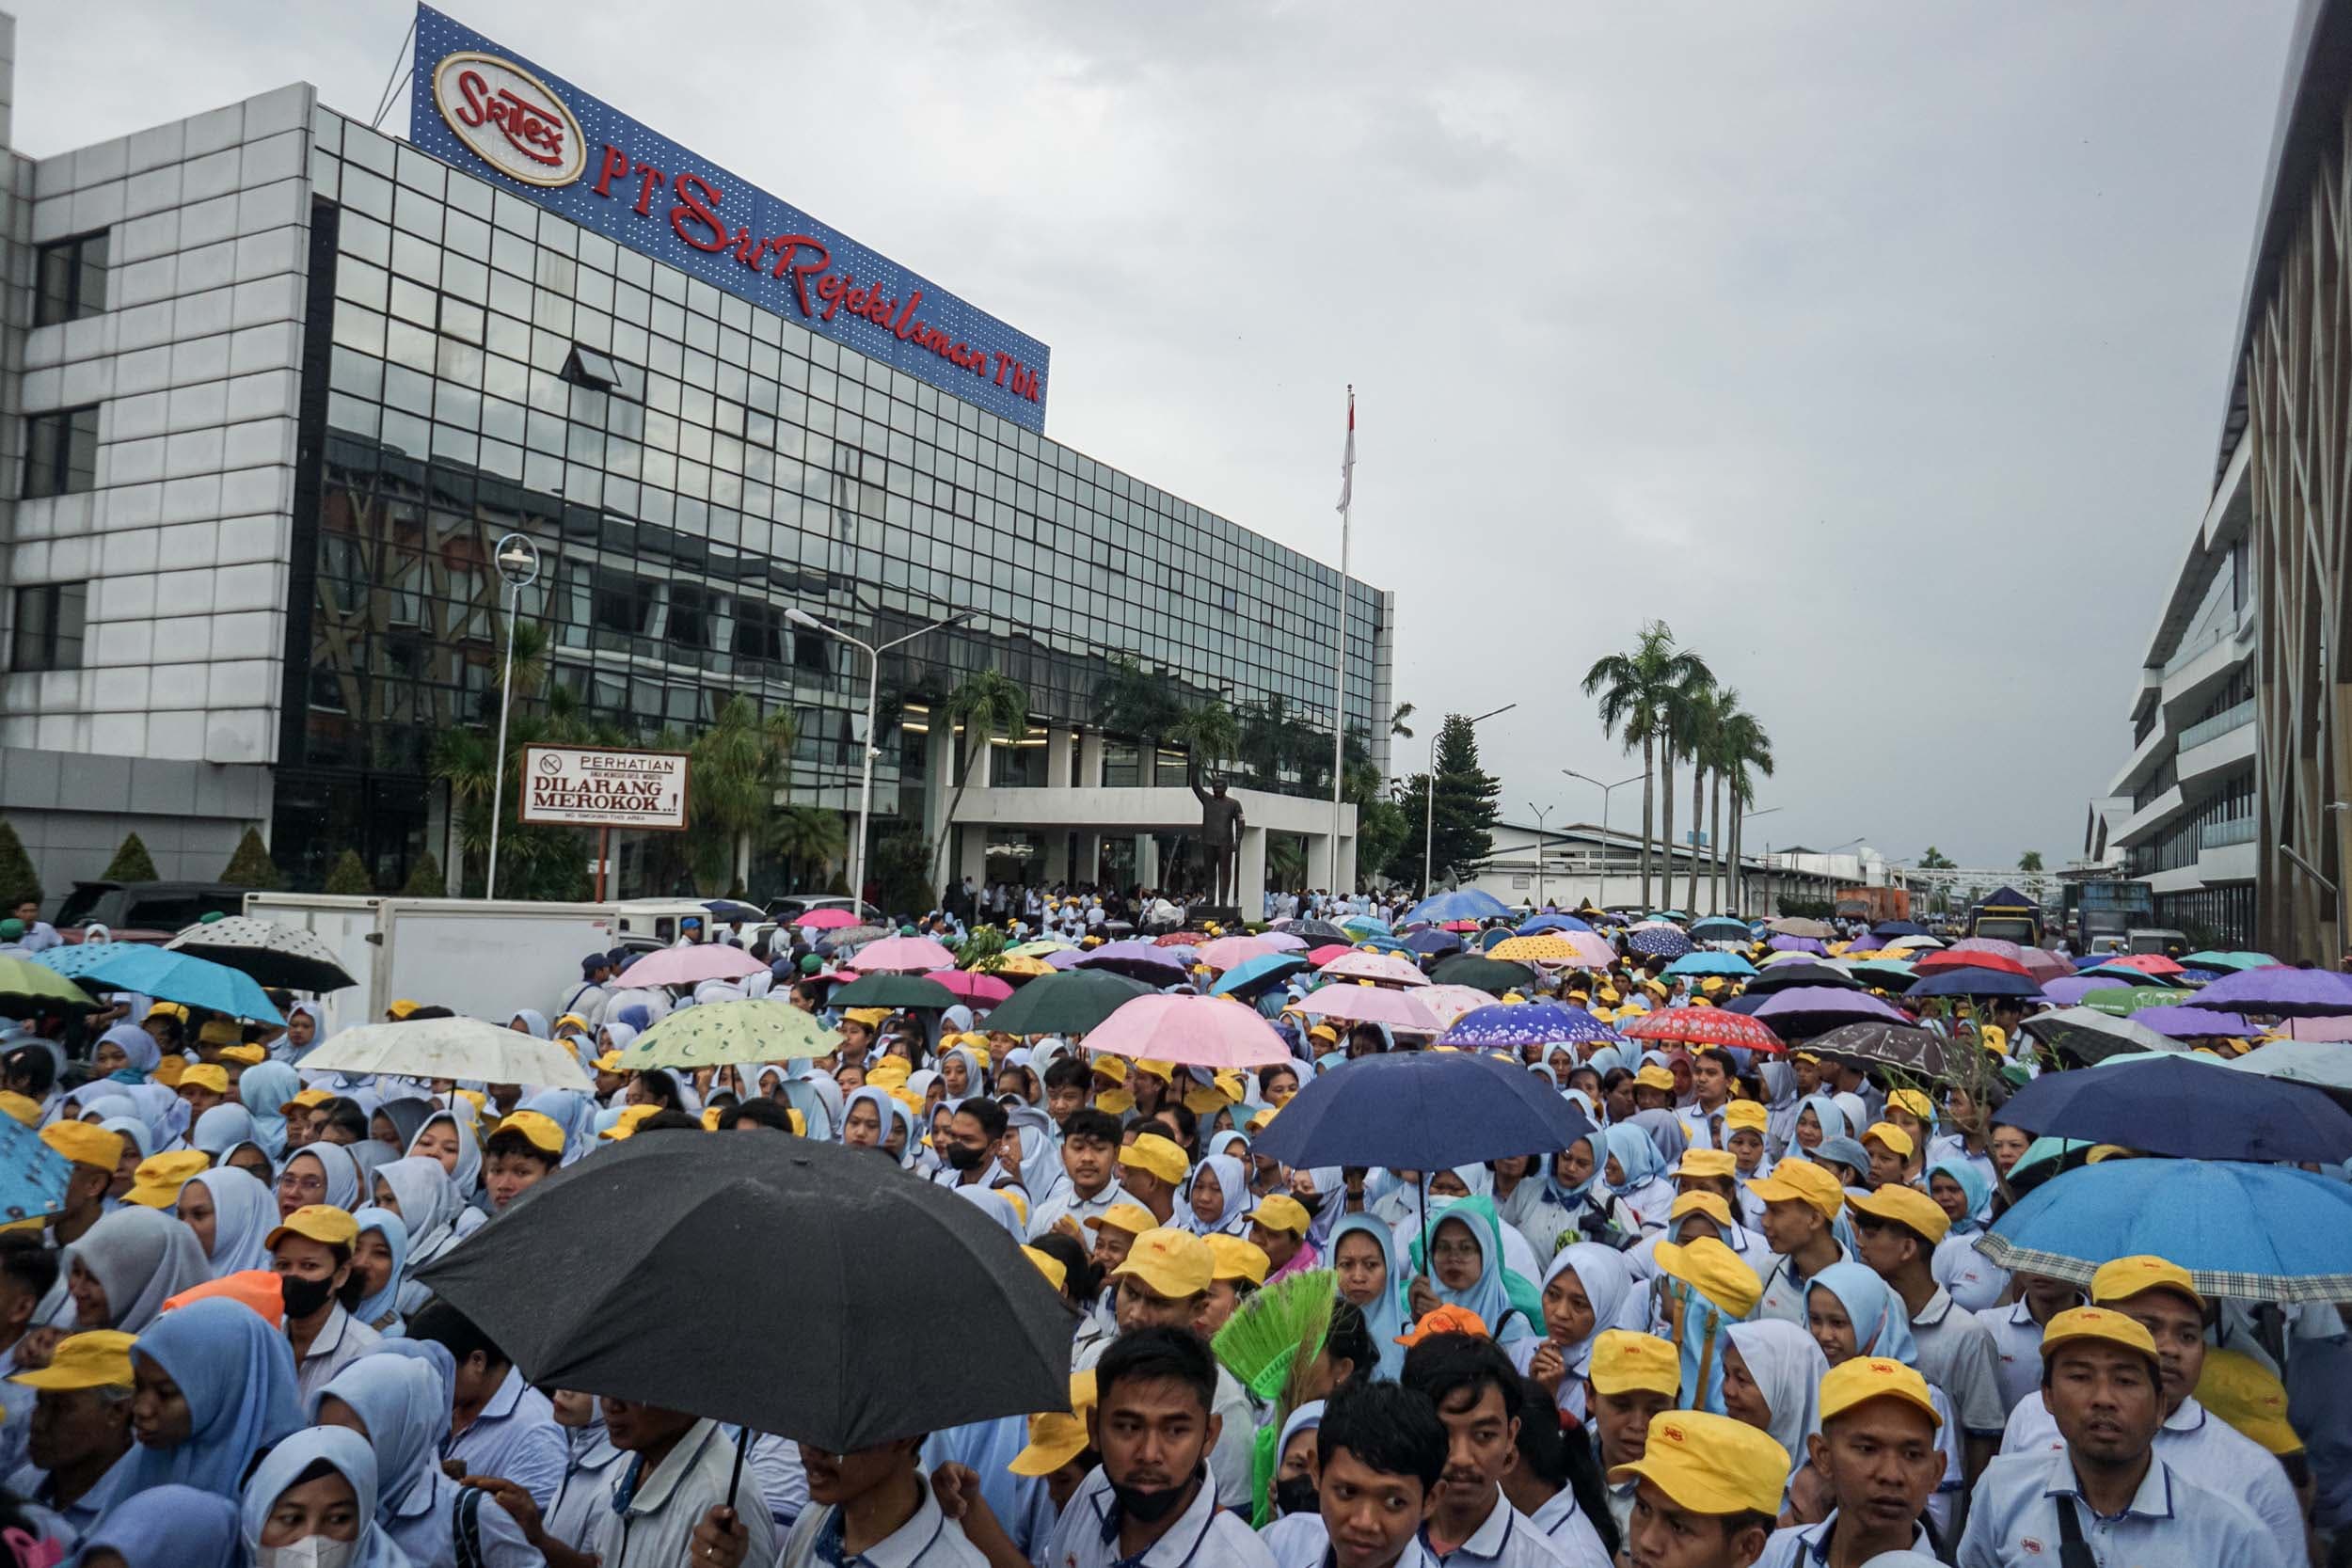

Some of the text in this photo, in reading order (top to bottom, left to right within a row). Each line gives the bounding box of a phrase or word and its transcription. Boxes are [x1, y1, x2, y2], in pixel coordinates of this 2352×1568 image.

[592, 144, 666, 217] PT
[670, 173, 769, 271] Sri
[773, 233, 898, 330] Rejeki
[993, 351, 1041, 403] Tbk
[580, 755, 675, 771] PERHATIAN
[533, 776, 663, 797] DILARANG
